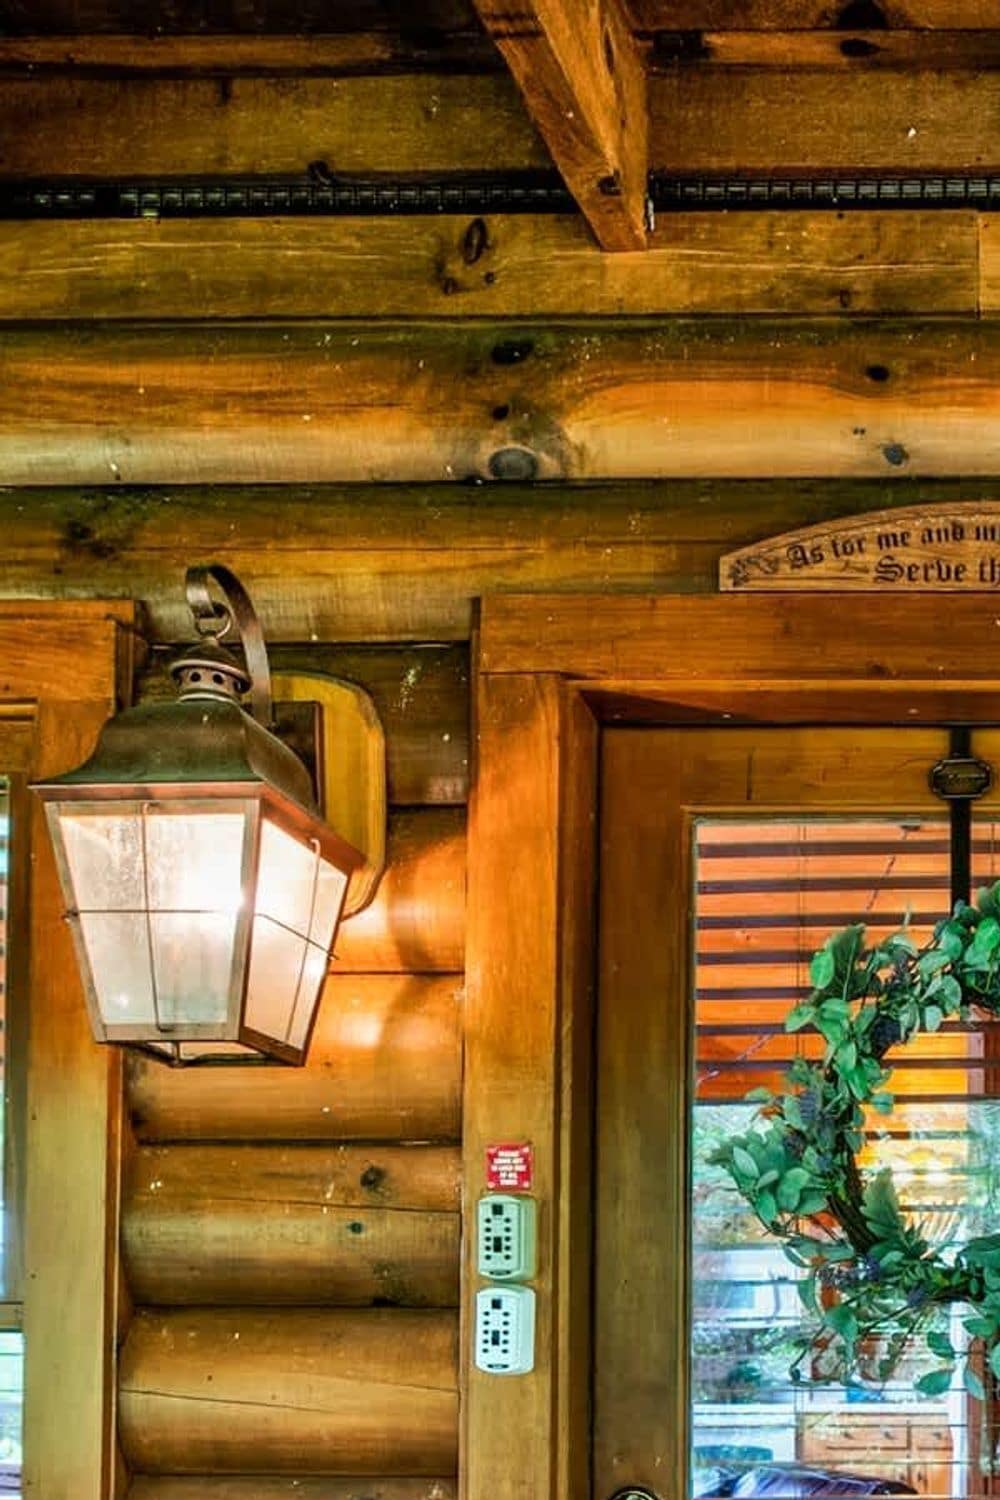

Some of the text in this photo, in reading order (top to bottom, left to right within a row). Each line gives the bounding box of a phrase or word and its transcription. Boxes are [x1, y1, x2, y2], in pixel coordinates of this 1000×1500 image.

[786, 543, 824, 569] As
[831, 536, 866, 559] for
[877, 530, 911, 550] me
[922, 521, 965, 544] and
[873, 555, 967, 582] Serve
